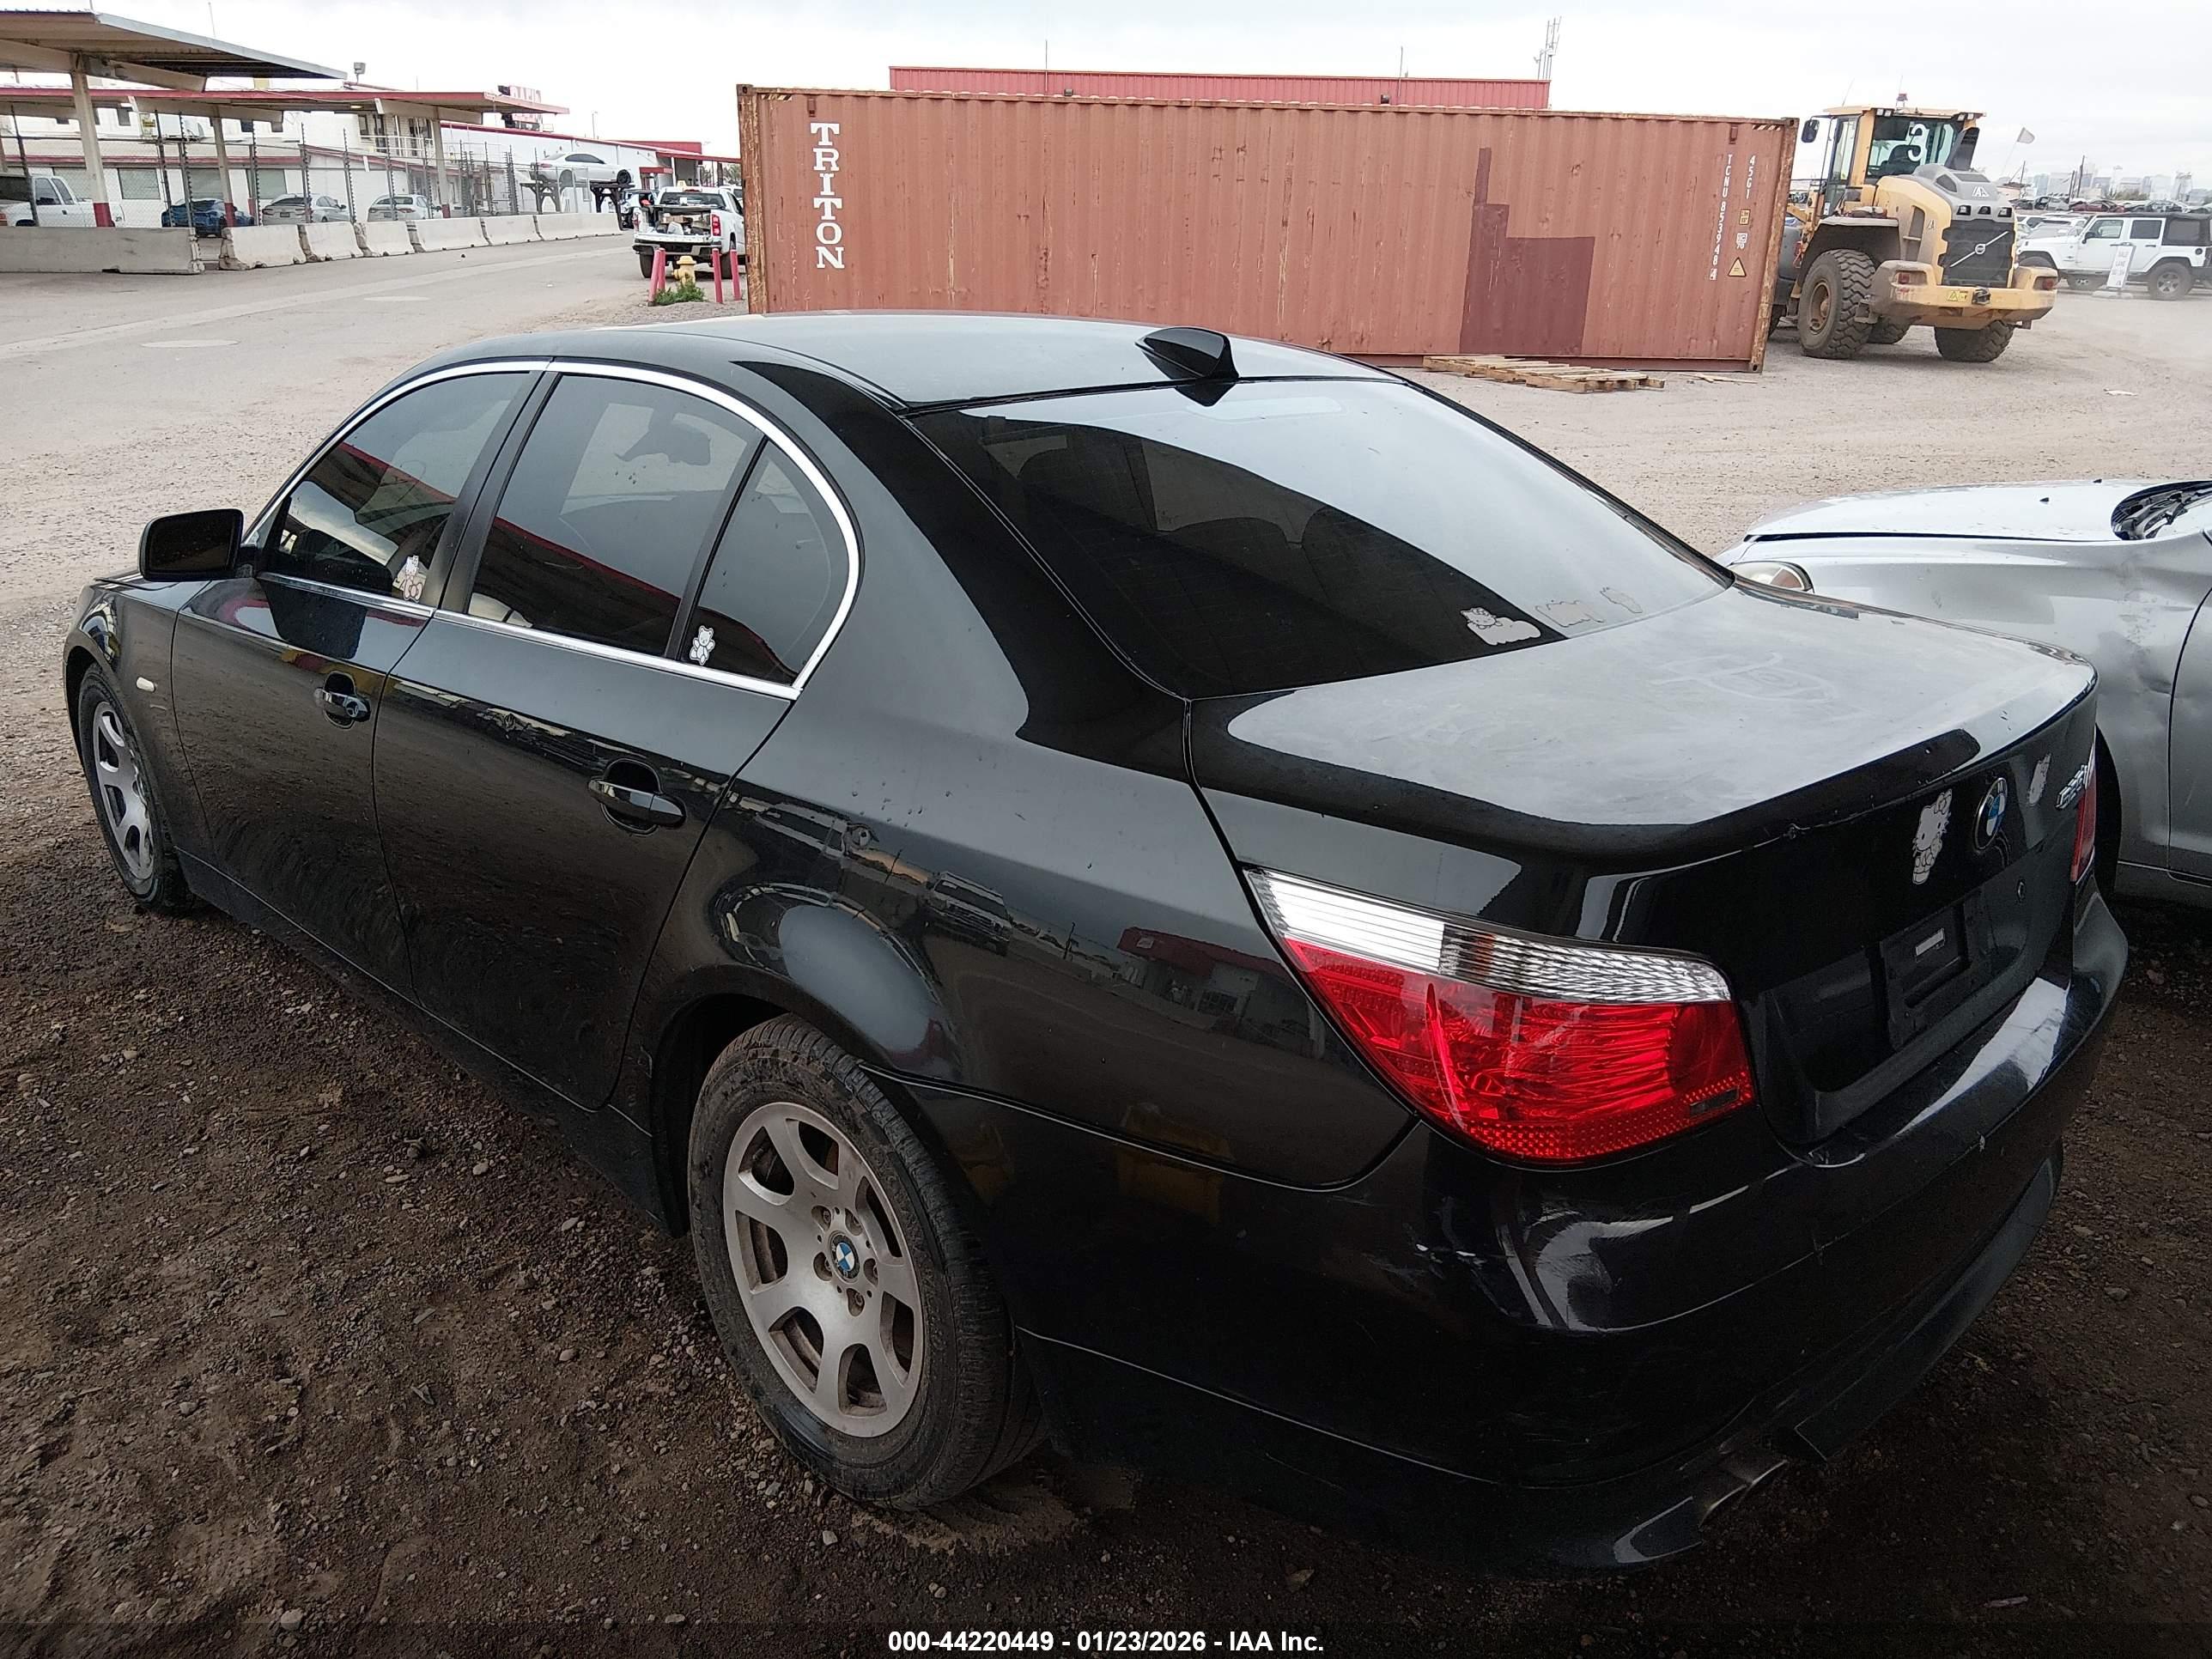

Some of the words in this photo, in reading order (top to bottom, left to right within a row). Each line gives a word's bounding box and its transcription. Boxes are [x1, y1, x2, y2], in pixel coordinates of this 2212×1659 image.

[811, 123, 845, 269] TRITON
[1722, 154, 1733, 198] TCNU
[1746, 155, 1756, 199] 45G1
[1712, 201, 1726, 265] 853948
